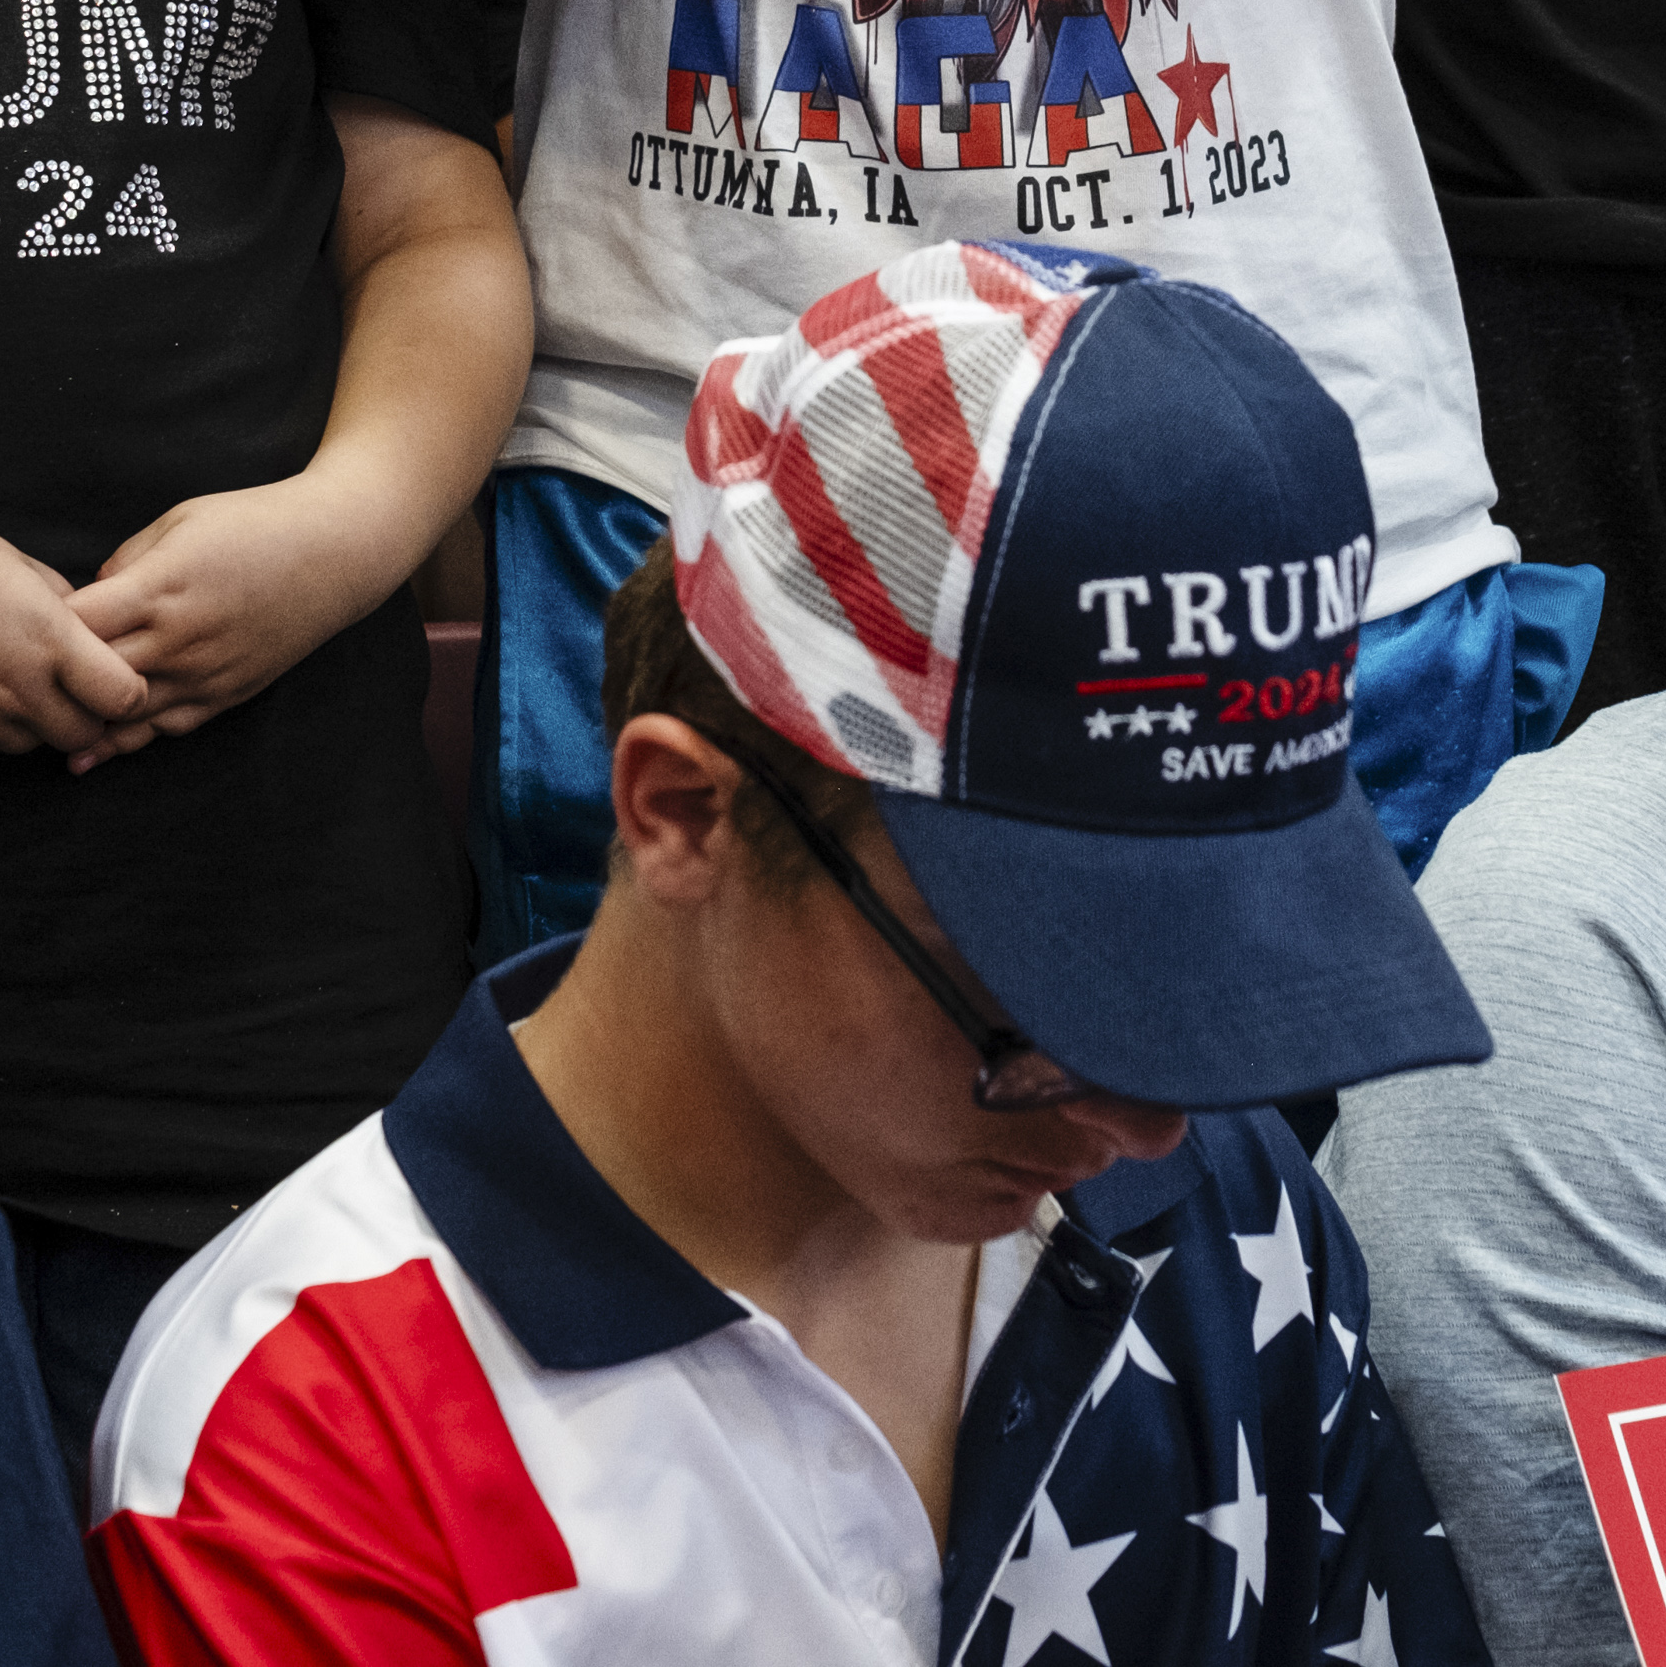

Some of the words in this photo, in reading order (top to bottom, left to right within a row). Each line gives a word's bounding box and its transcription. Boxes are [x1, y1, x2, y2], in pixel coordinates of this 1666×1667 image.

[864, 166, 919, 228] IA
[1017, 169, 1134, 235] OCT.
[1159, 158, 1195, 220] 1,
[1205, 129, 1292, 206] 2023
[1162, 742, 1256, 781] SAVE
